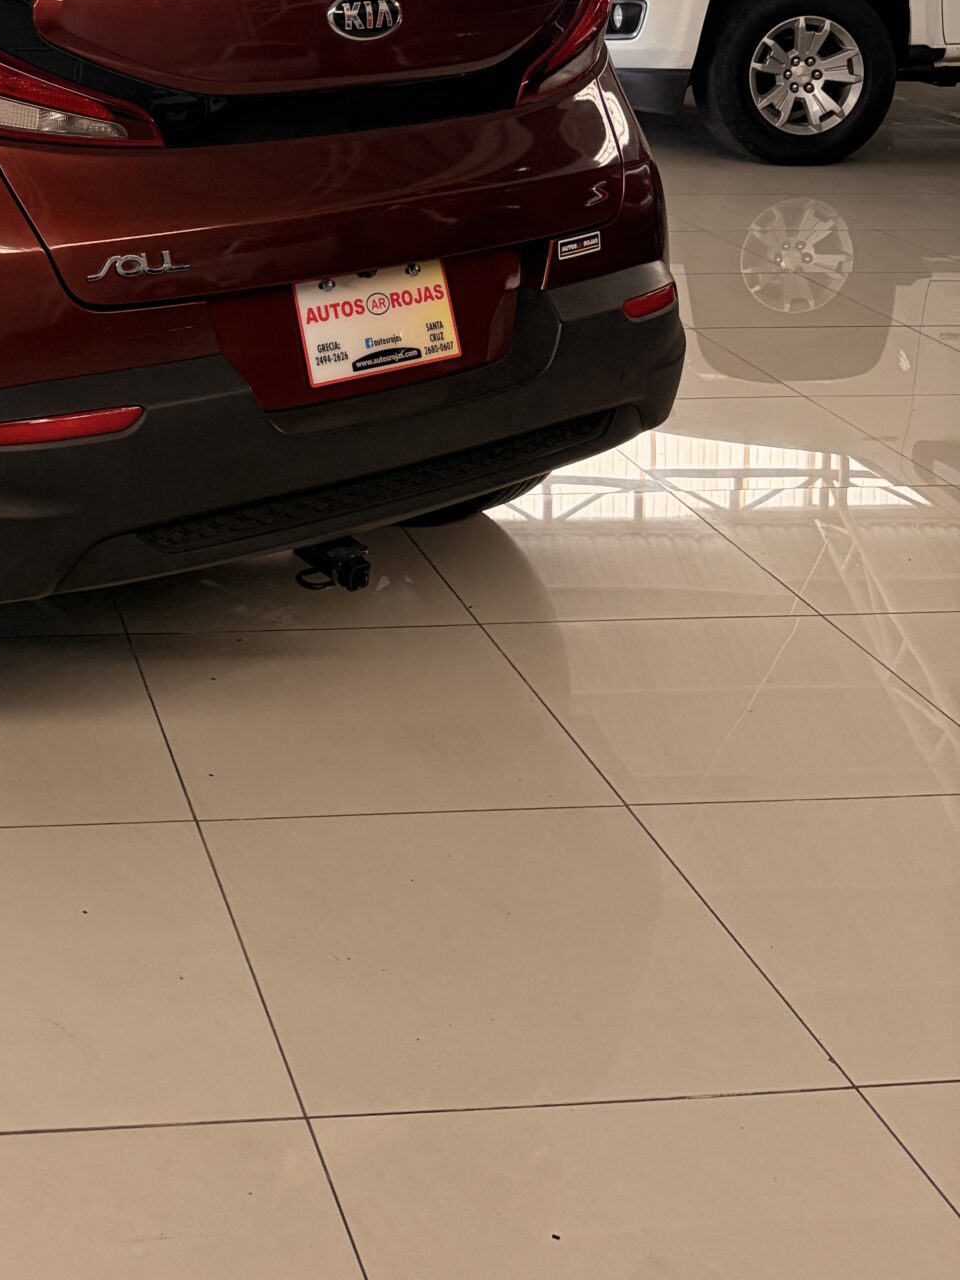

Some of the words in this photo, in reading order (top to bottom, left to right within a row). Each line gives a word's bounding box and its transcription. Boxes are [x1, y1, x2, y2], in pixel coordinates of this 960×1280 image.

[341, 0, 393, 30] KIA
[584, 180, 609, 207] S
[305, 298, 366, 325] AUTOS
[371, 298, 387, 311] AR
[389, 284, 445, 308] ROJAS
[425, 320, 444, 332] SANTA
[373, 334, 402, 347] autosrojas
[429, 332, 445, 343] CRUZ
[316, 341, 341, 354] GRECIA:
